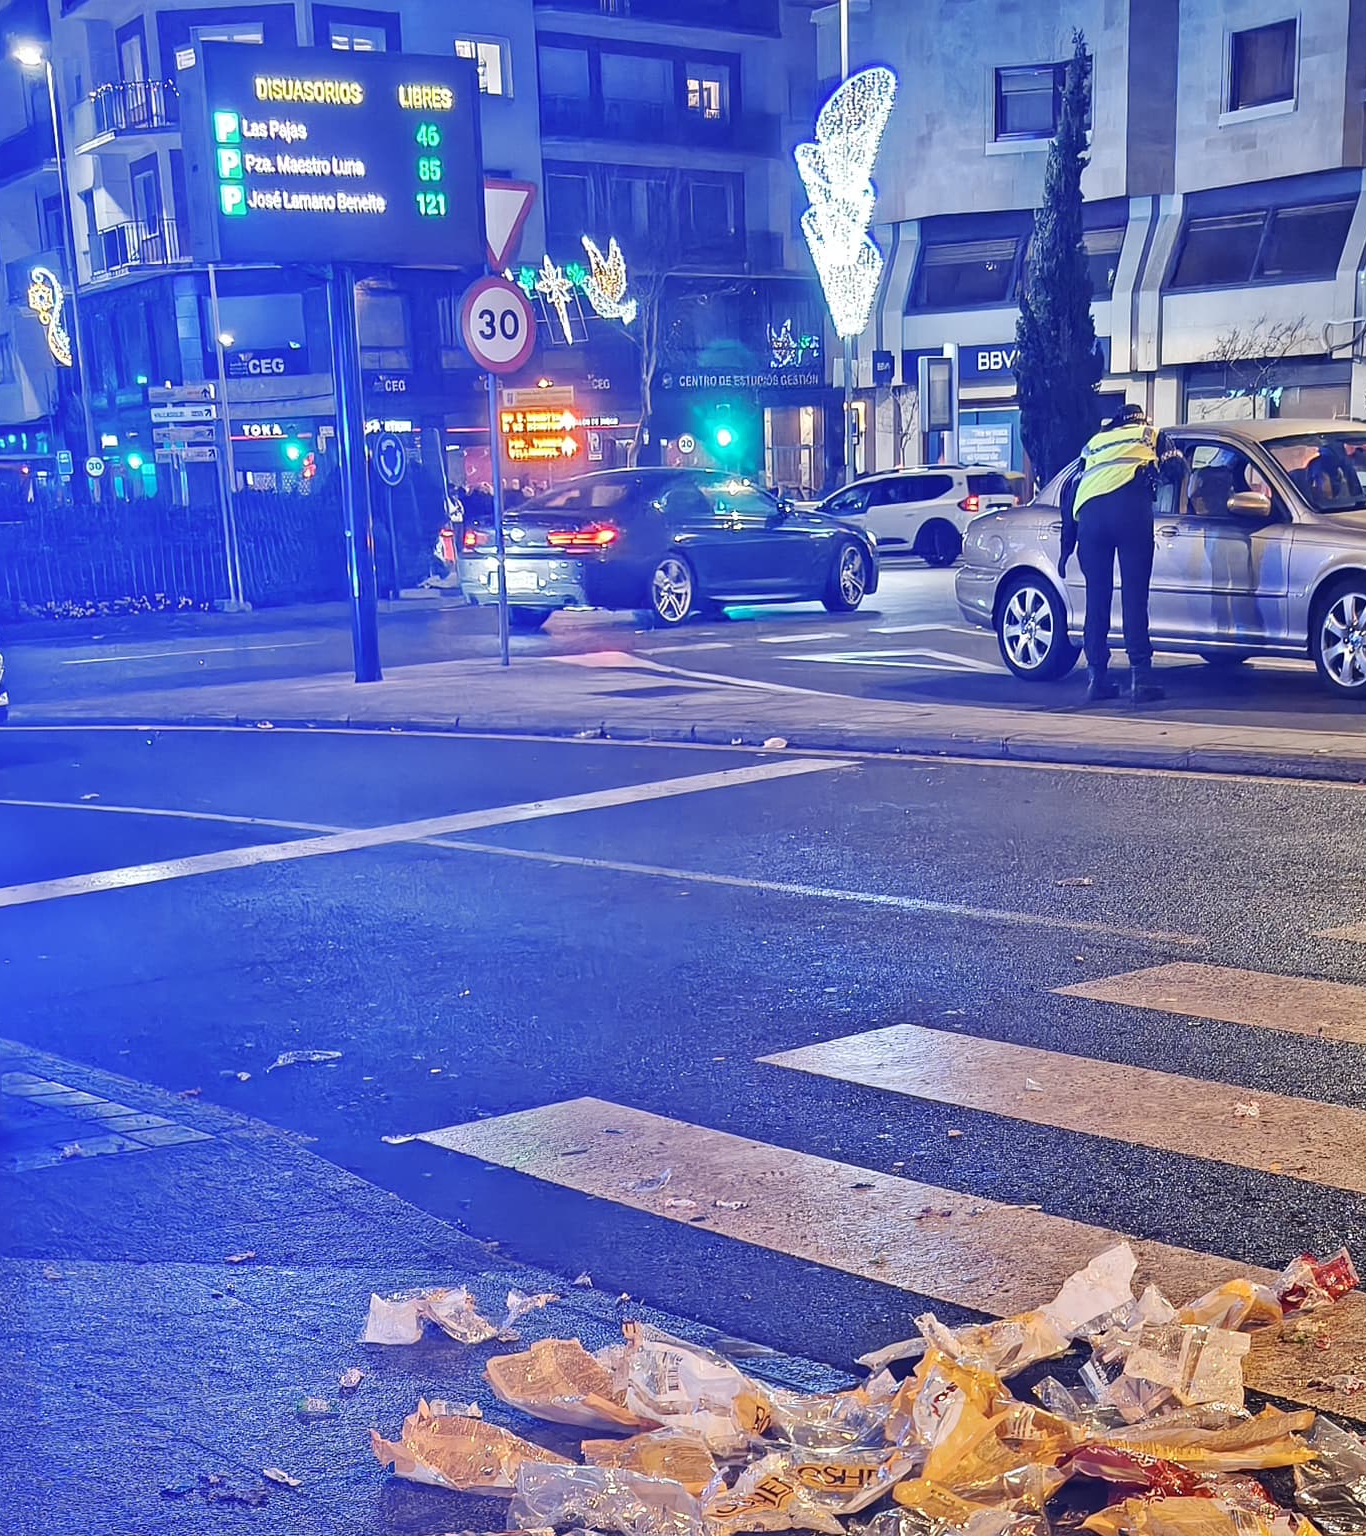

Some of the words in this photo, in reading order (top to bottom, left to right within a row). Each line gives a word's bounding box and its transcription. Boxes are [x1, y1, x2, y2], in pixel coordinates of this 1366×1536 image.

[254, 76, 364, 104] DISUASORIOS
[398, 84, 454, 110] LIBRES
[242, 118, 267, 139] Las
[269, 119, 308, 144] Pajas
[416, 124, 440, 147] 46
[245, 155, 275, 175] Pza.
[277, 155, 332, 177] Maestro
[332, 157, 365, 178] Luna
[248, 189, 282, 210] José
[282, 190, 337, 212] Lamano
[416, 193, 447, 216] 121
[478, 308, 520, 341] 30
[248, 357, 285, 375] CEG
[977, 351, 1019, 371] BBV
[385, 379, 406, 392] CEG
[679, 374, 717, 387] CENTRO
[719, 374, 732, 386] DE
[735, 374, 779, 386] ESTUDIOS
[88, 461, 103, 471] 30
